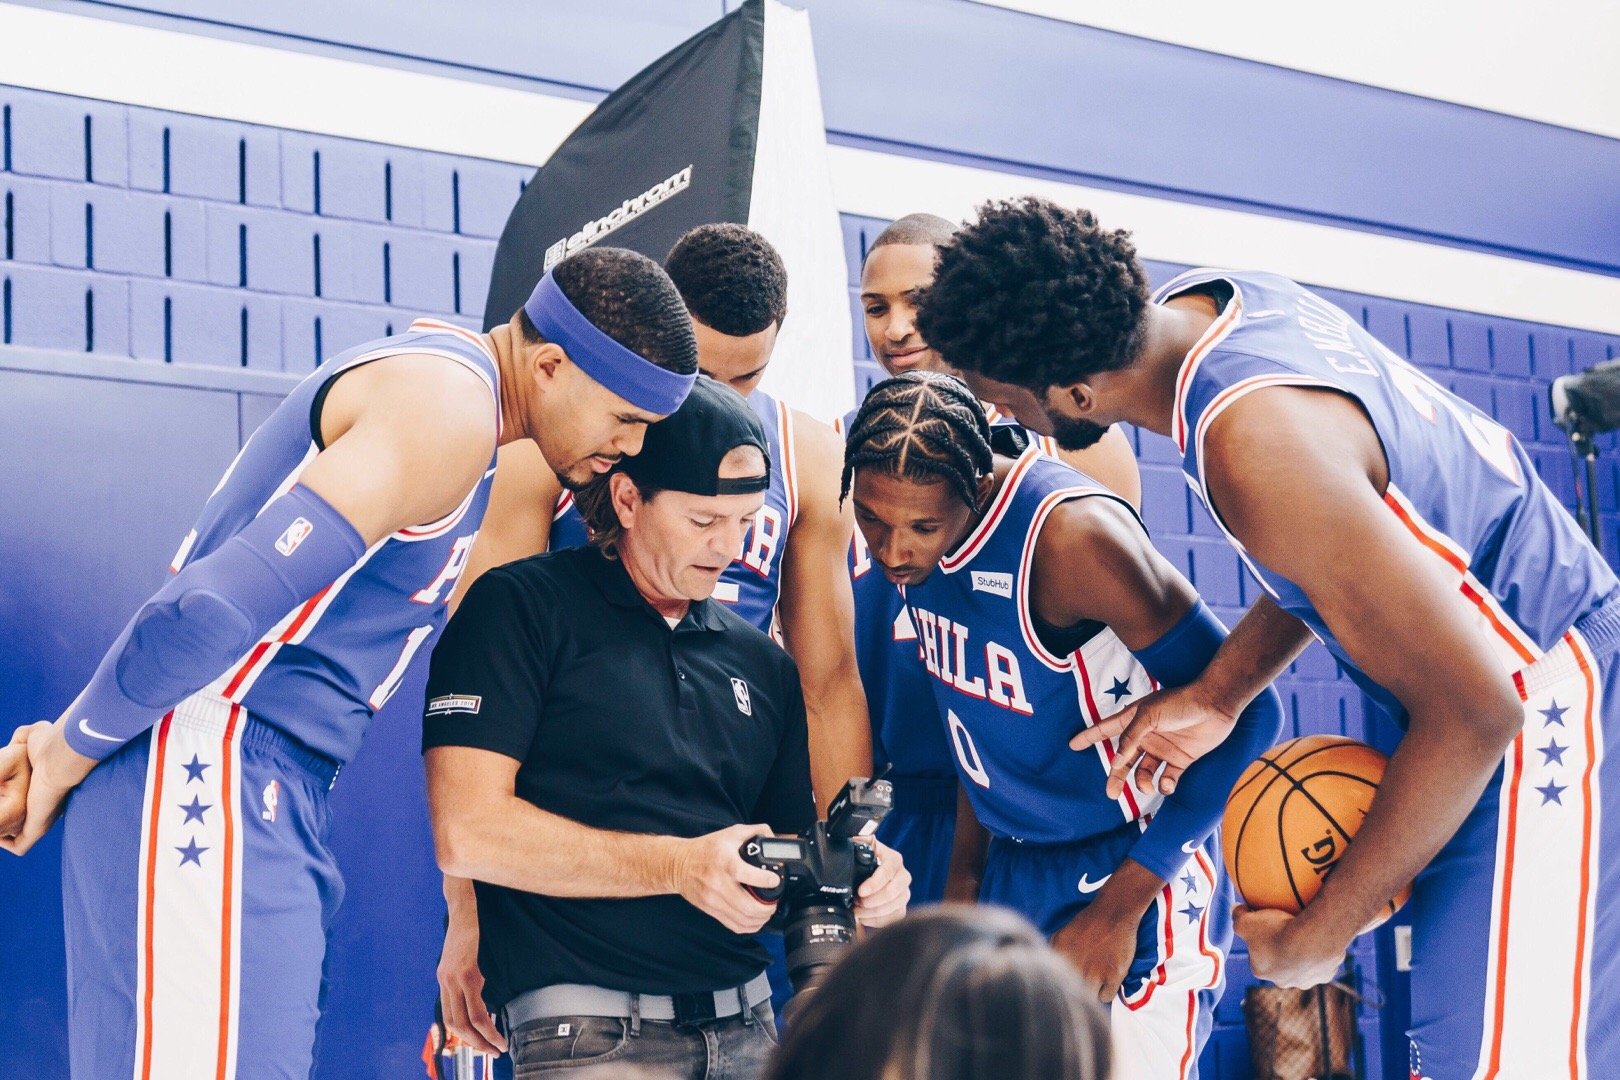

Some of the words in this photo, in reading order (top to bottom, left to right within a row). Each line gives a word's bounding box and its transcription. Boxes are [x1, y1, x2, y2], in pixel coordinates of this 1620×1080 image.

[566, 166, 692, 251] elinchrom
[977, 576, 1009, 590] StubHub
[911, 606, 1034, 716] HILA
[947, 708, 990, 789] 0
